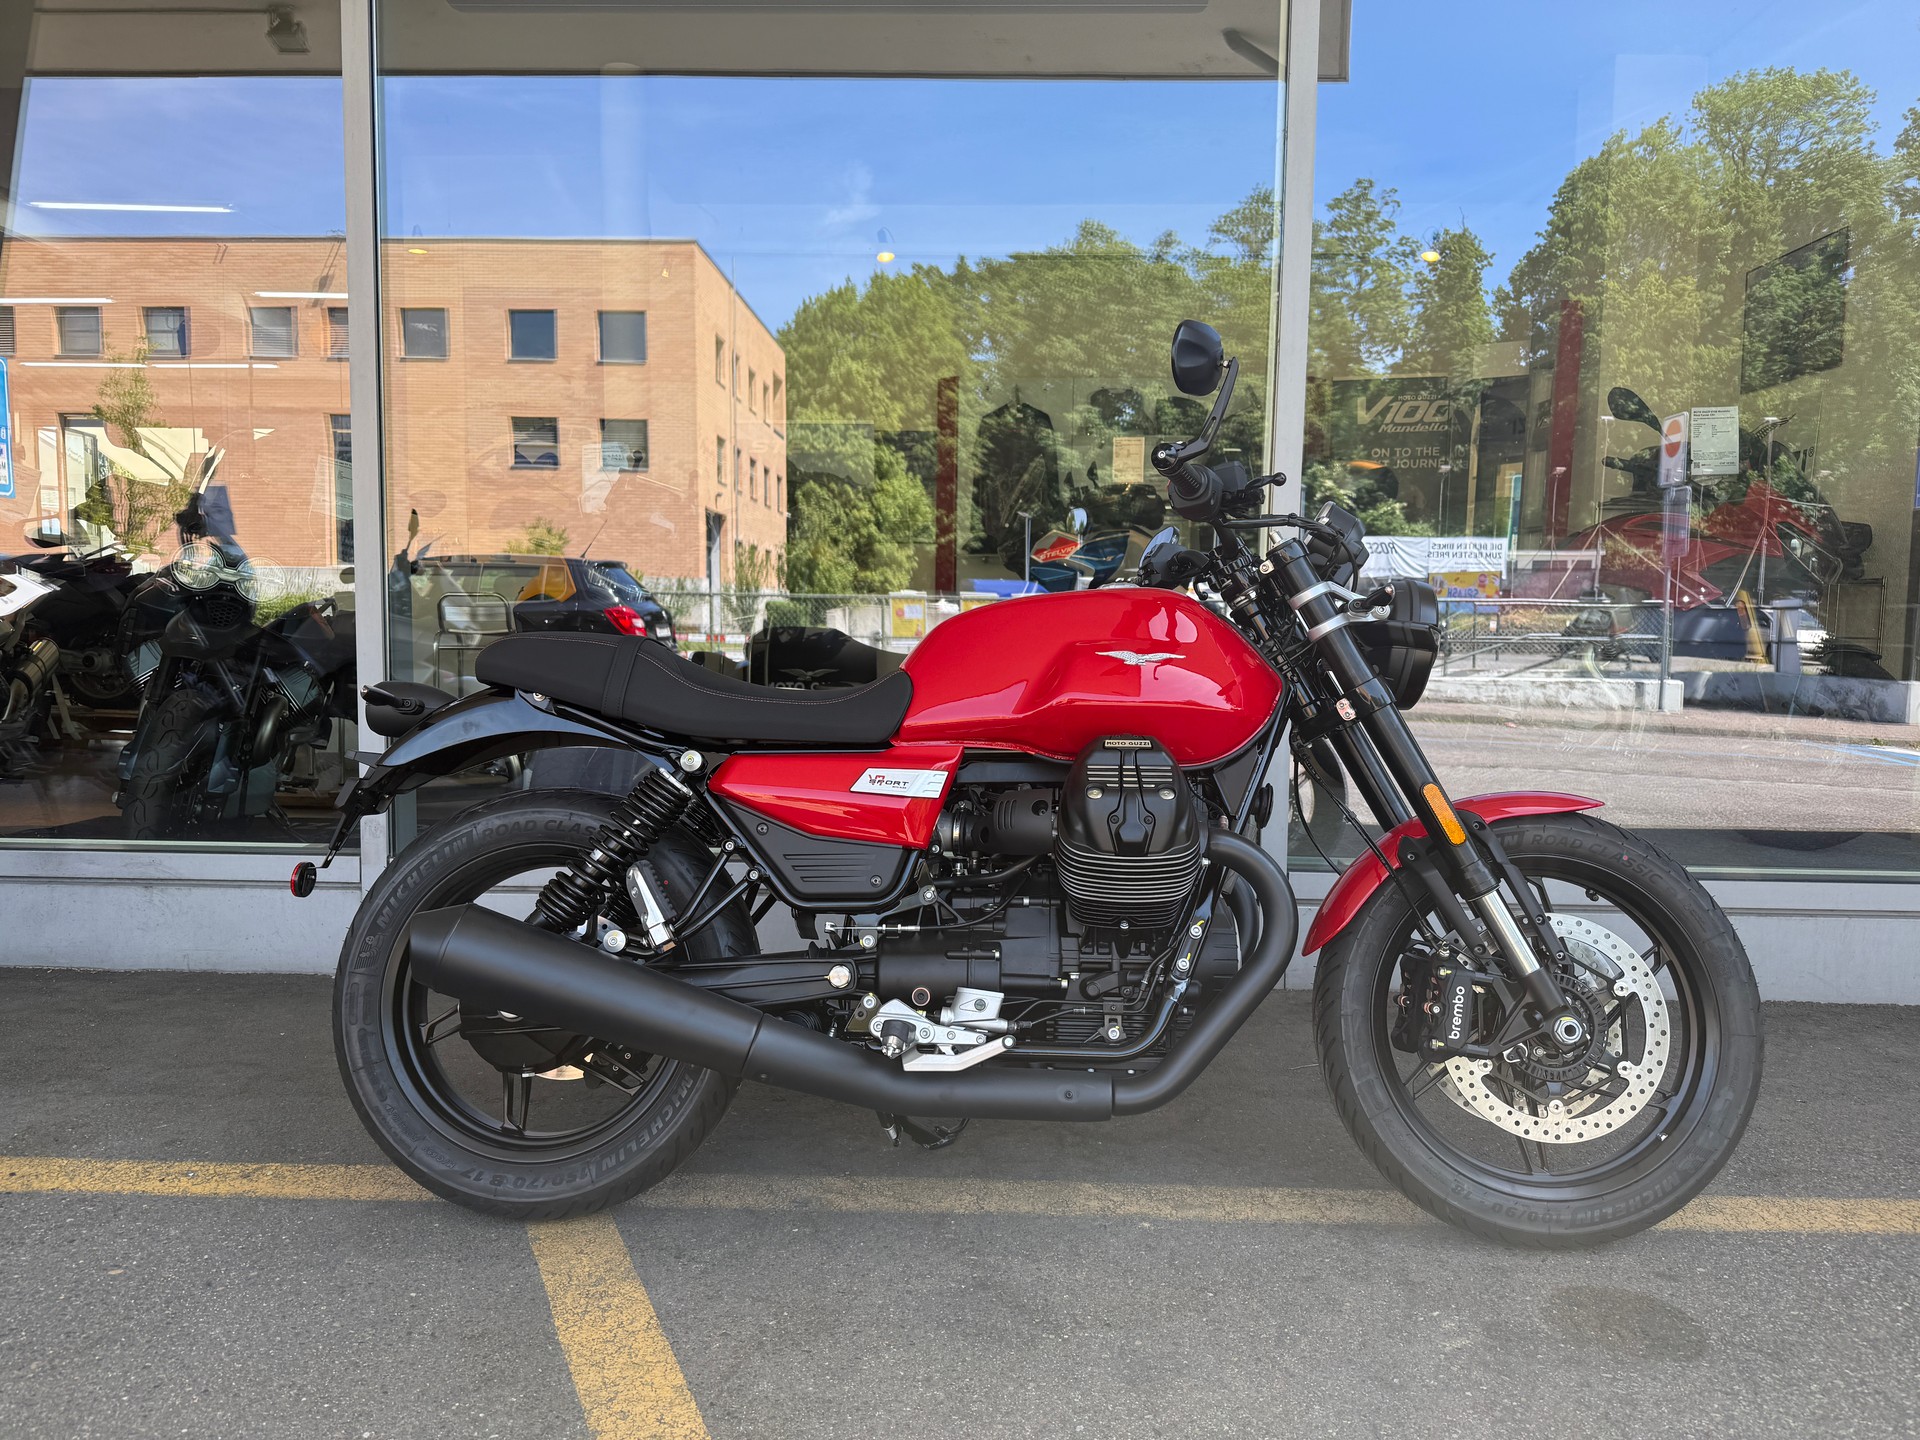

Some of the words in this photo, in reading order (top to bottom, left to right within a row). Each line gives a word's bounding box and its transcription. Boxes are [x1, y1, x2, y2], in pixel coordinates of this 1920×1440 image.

[1371, 447, 1390, 458] ON
[1394, 447, 1412, 457] TO
[1415, 446, 1441, 457] THE
[1378, 423, 1449, 433] Mandello
[376, 834, 469, 930] MICHELIN
[481, 819, 537, 842] ROAD
[543, 819, 599, 838] CLAS
[1531, 833, 1583, 850] ROAD
[1588, 842, 1663, 885] CLASSIC
[1448, 986, 1465, 1040] brembo
[602, 1074, 694, 1171] MICHELIN
[1575, 1173, 1681, 1225] MICHELIN
